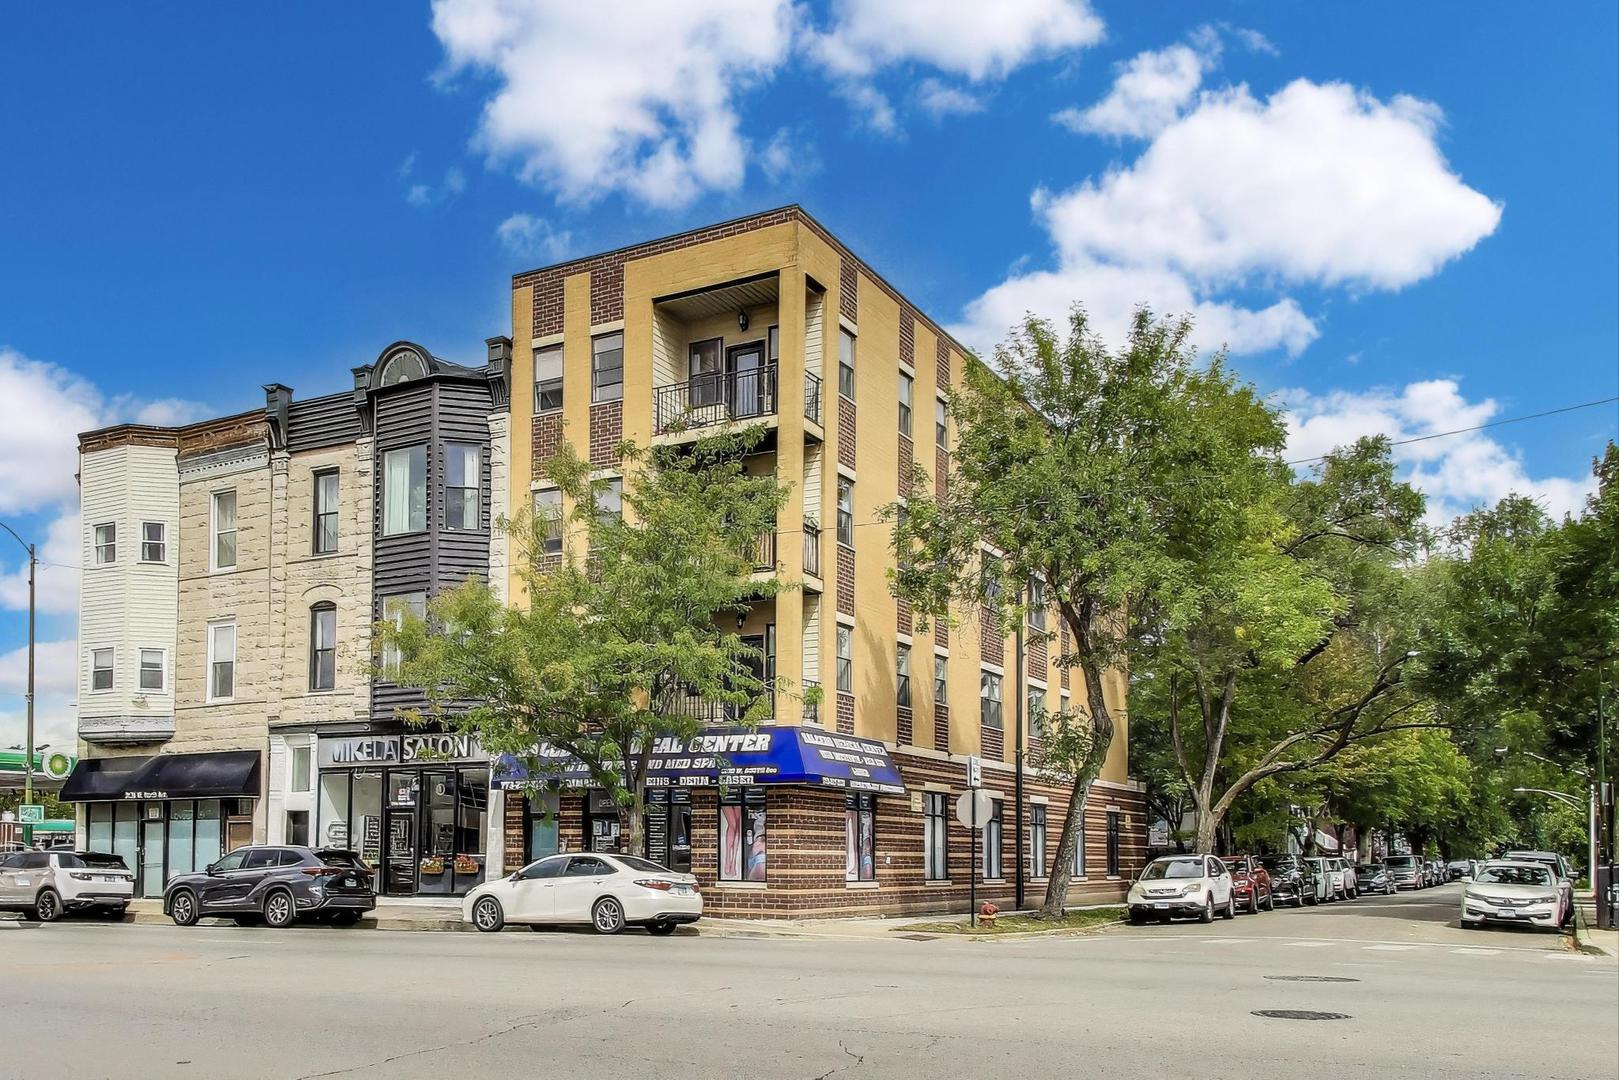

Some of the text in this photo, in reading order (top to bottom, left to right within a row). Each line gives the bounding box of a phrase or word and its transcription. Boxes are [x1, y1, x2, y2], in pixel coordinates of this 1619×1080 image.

[331, 739, 398, 762] MIKELA
[403, 735, 468, 761] SALON
[688, 734, 771, 754] CENTER
[665, 758, 691, 769] MED
